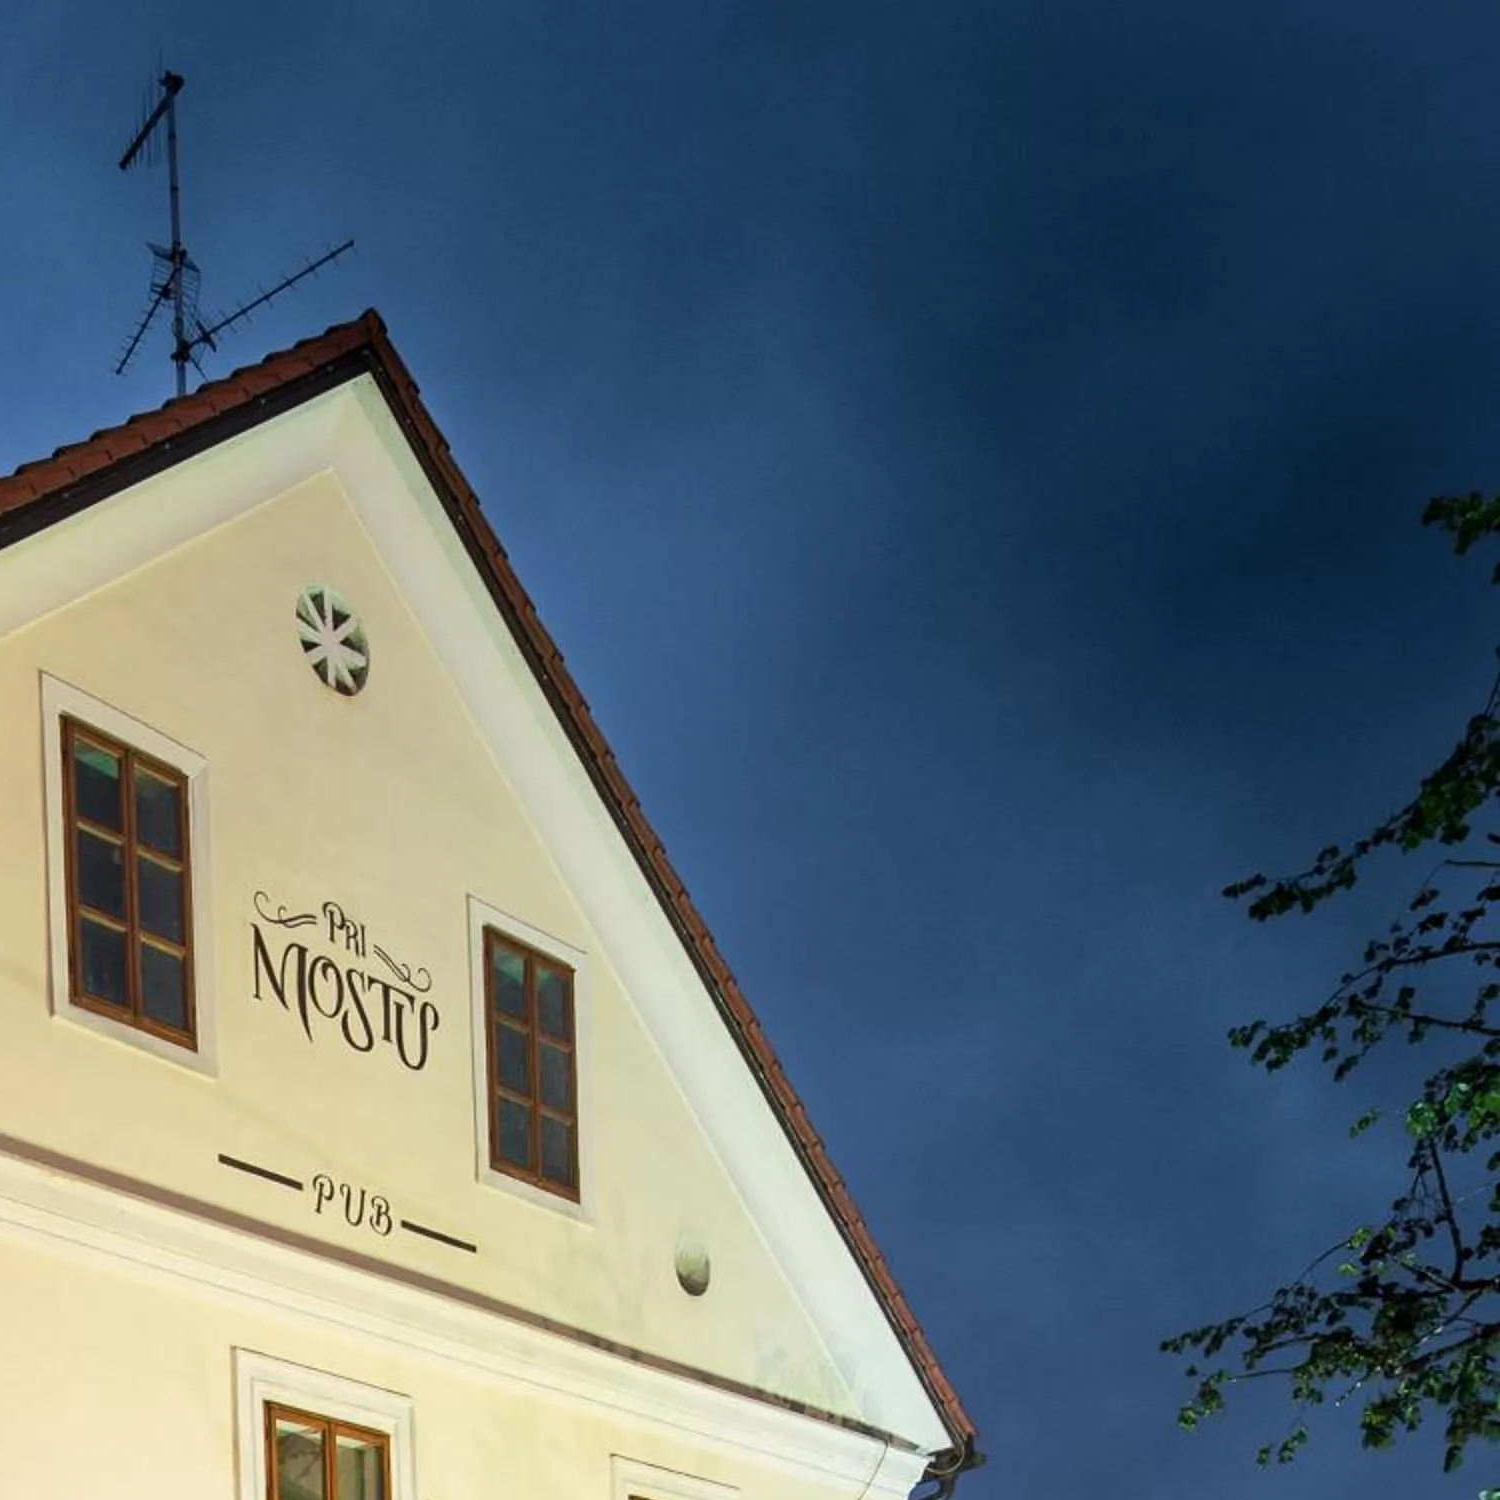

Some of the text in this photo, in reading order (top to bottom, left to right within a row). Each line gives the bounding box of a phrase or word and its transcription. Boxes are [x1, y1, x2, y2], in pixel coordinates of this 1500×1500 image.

[322, 901, 367, 958] PRI
[250, 922, 440, 1071] MOSTU
[311, 1172, 393, 1237] PUB
